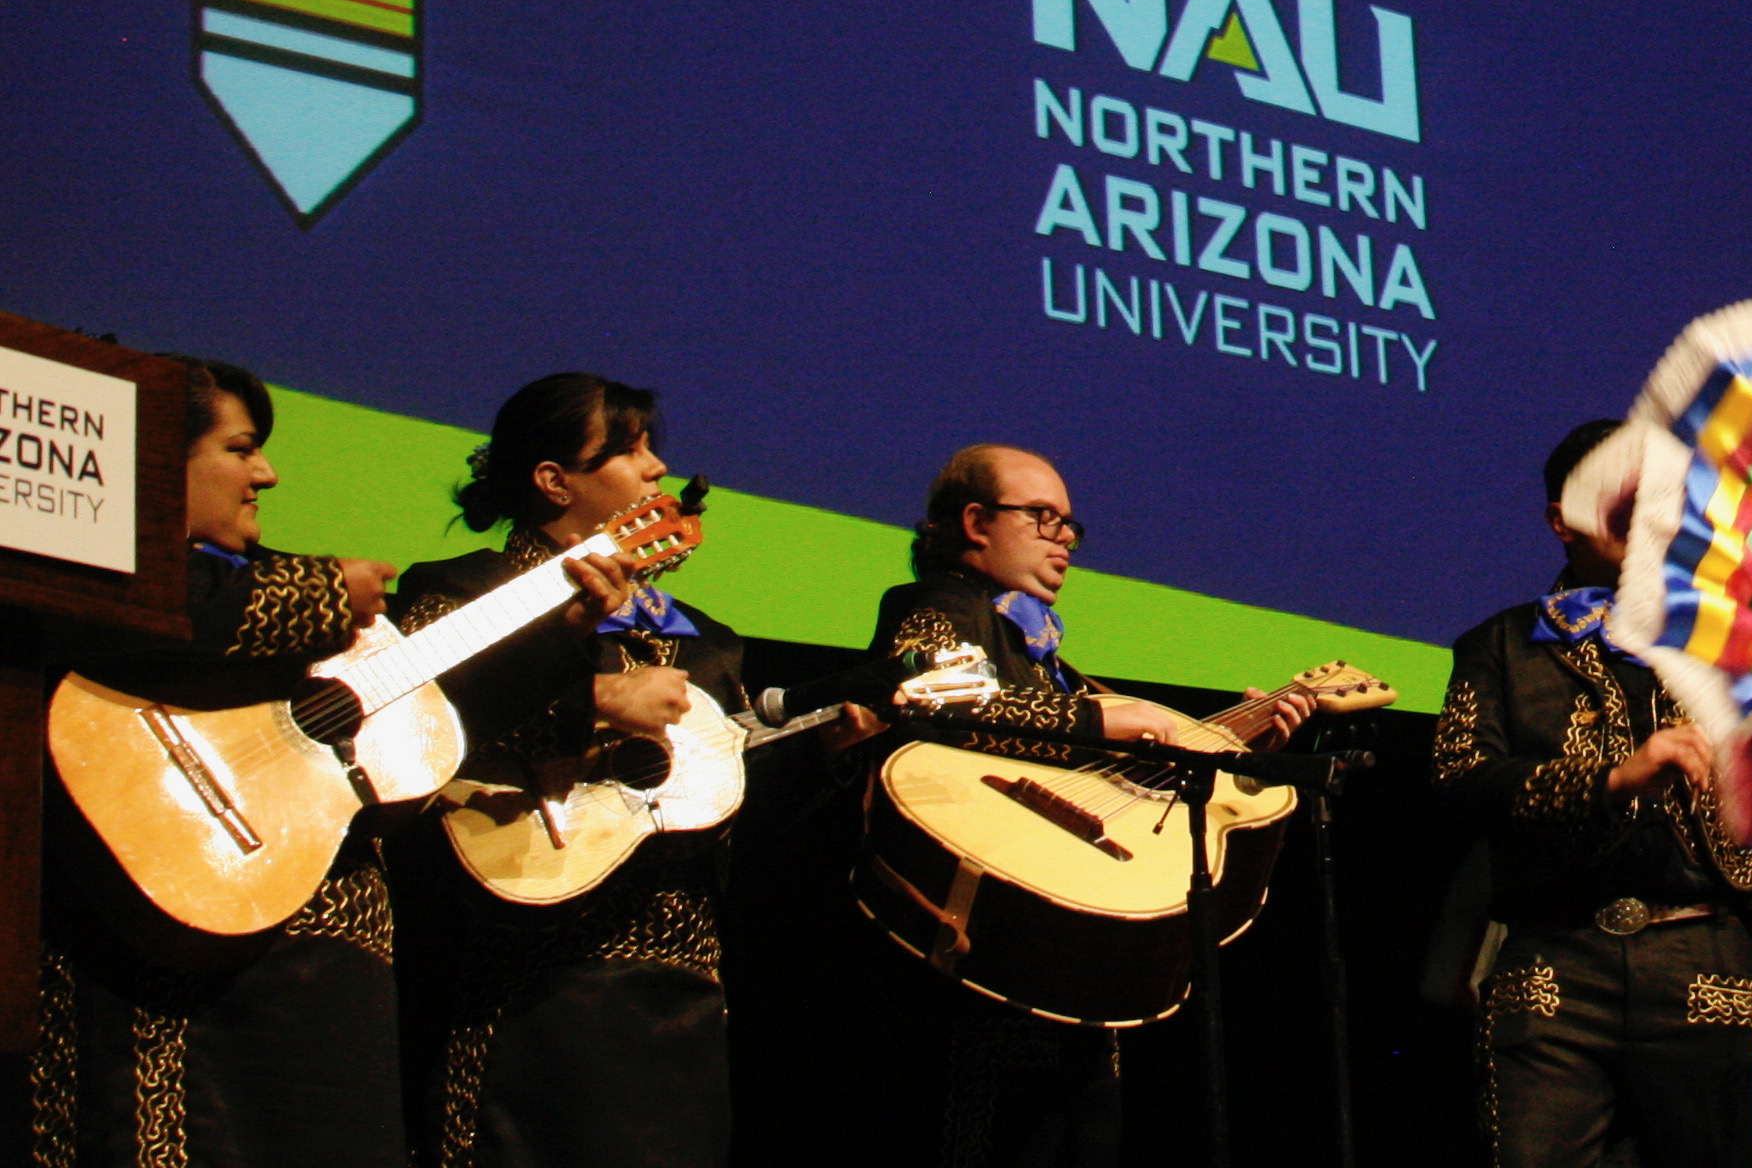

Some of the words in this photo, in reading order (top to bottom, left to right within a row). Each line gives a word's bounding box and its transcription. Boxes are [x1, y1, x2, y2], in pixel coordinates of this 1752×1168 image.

[1033, 78, 1427, 231] NORTHERN
[1034, 162, 1437, 321] ARIZONA
[1041, 256, 1438, 392] UNIVERSITY
